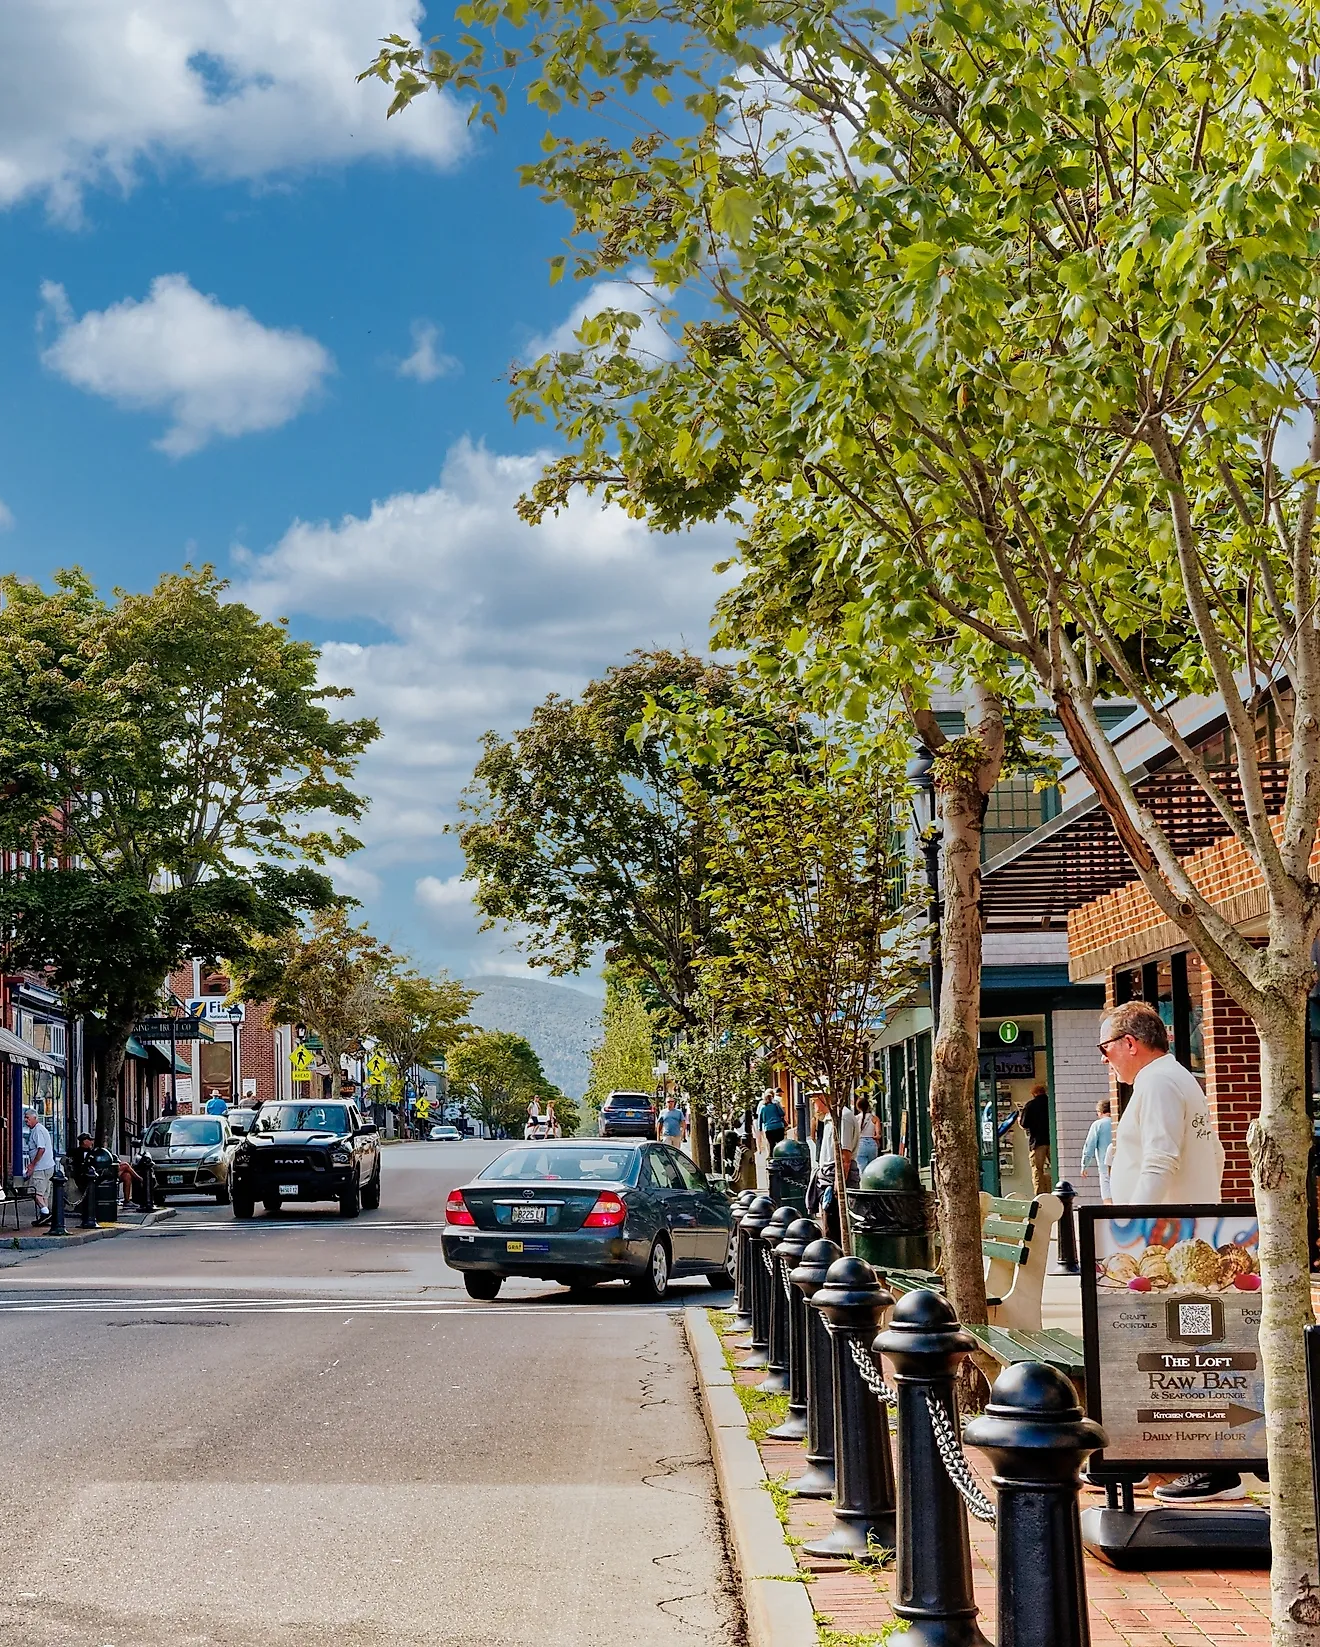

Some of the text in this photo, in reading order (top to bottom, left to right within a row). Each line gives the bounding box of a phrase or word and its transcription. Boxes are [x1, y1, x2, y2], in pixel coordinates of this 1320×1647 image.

[1161, 1354, 1233, 1367] THE LOFT
[1148, 1372, 1248, 1390] RAW BAR
[1150, 1390, 1246, 1400] & SEAFOOD LOUNGE
[1153, 1411, 1226, 1419] KITCHEN OPEN LATE
[1142, 1431, 1246, 1441] DAILY HAPPY HOUR
